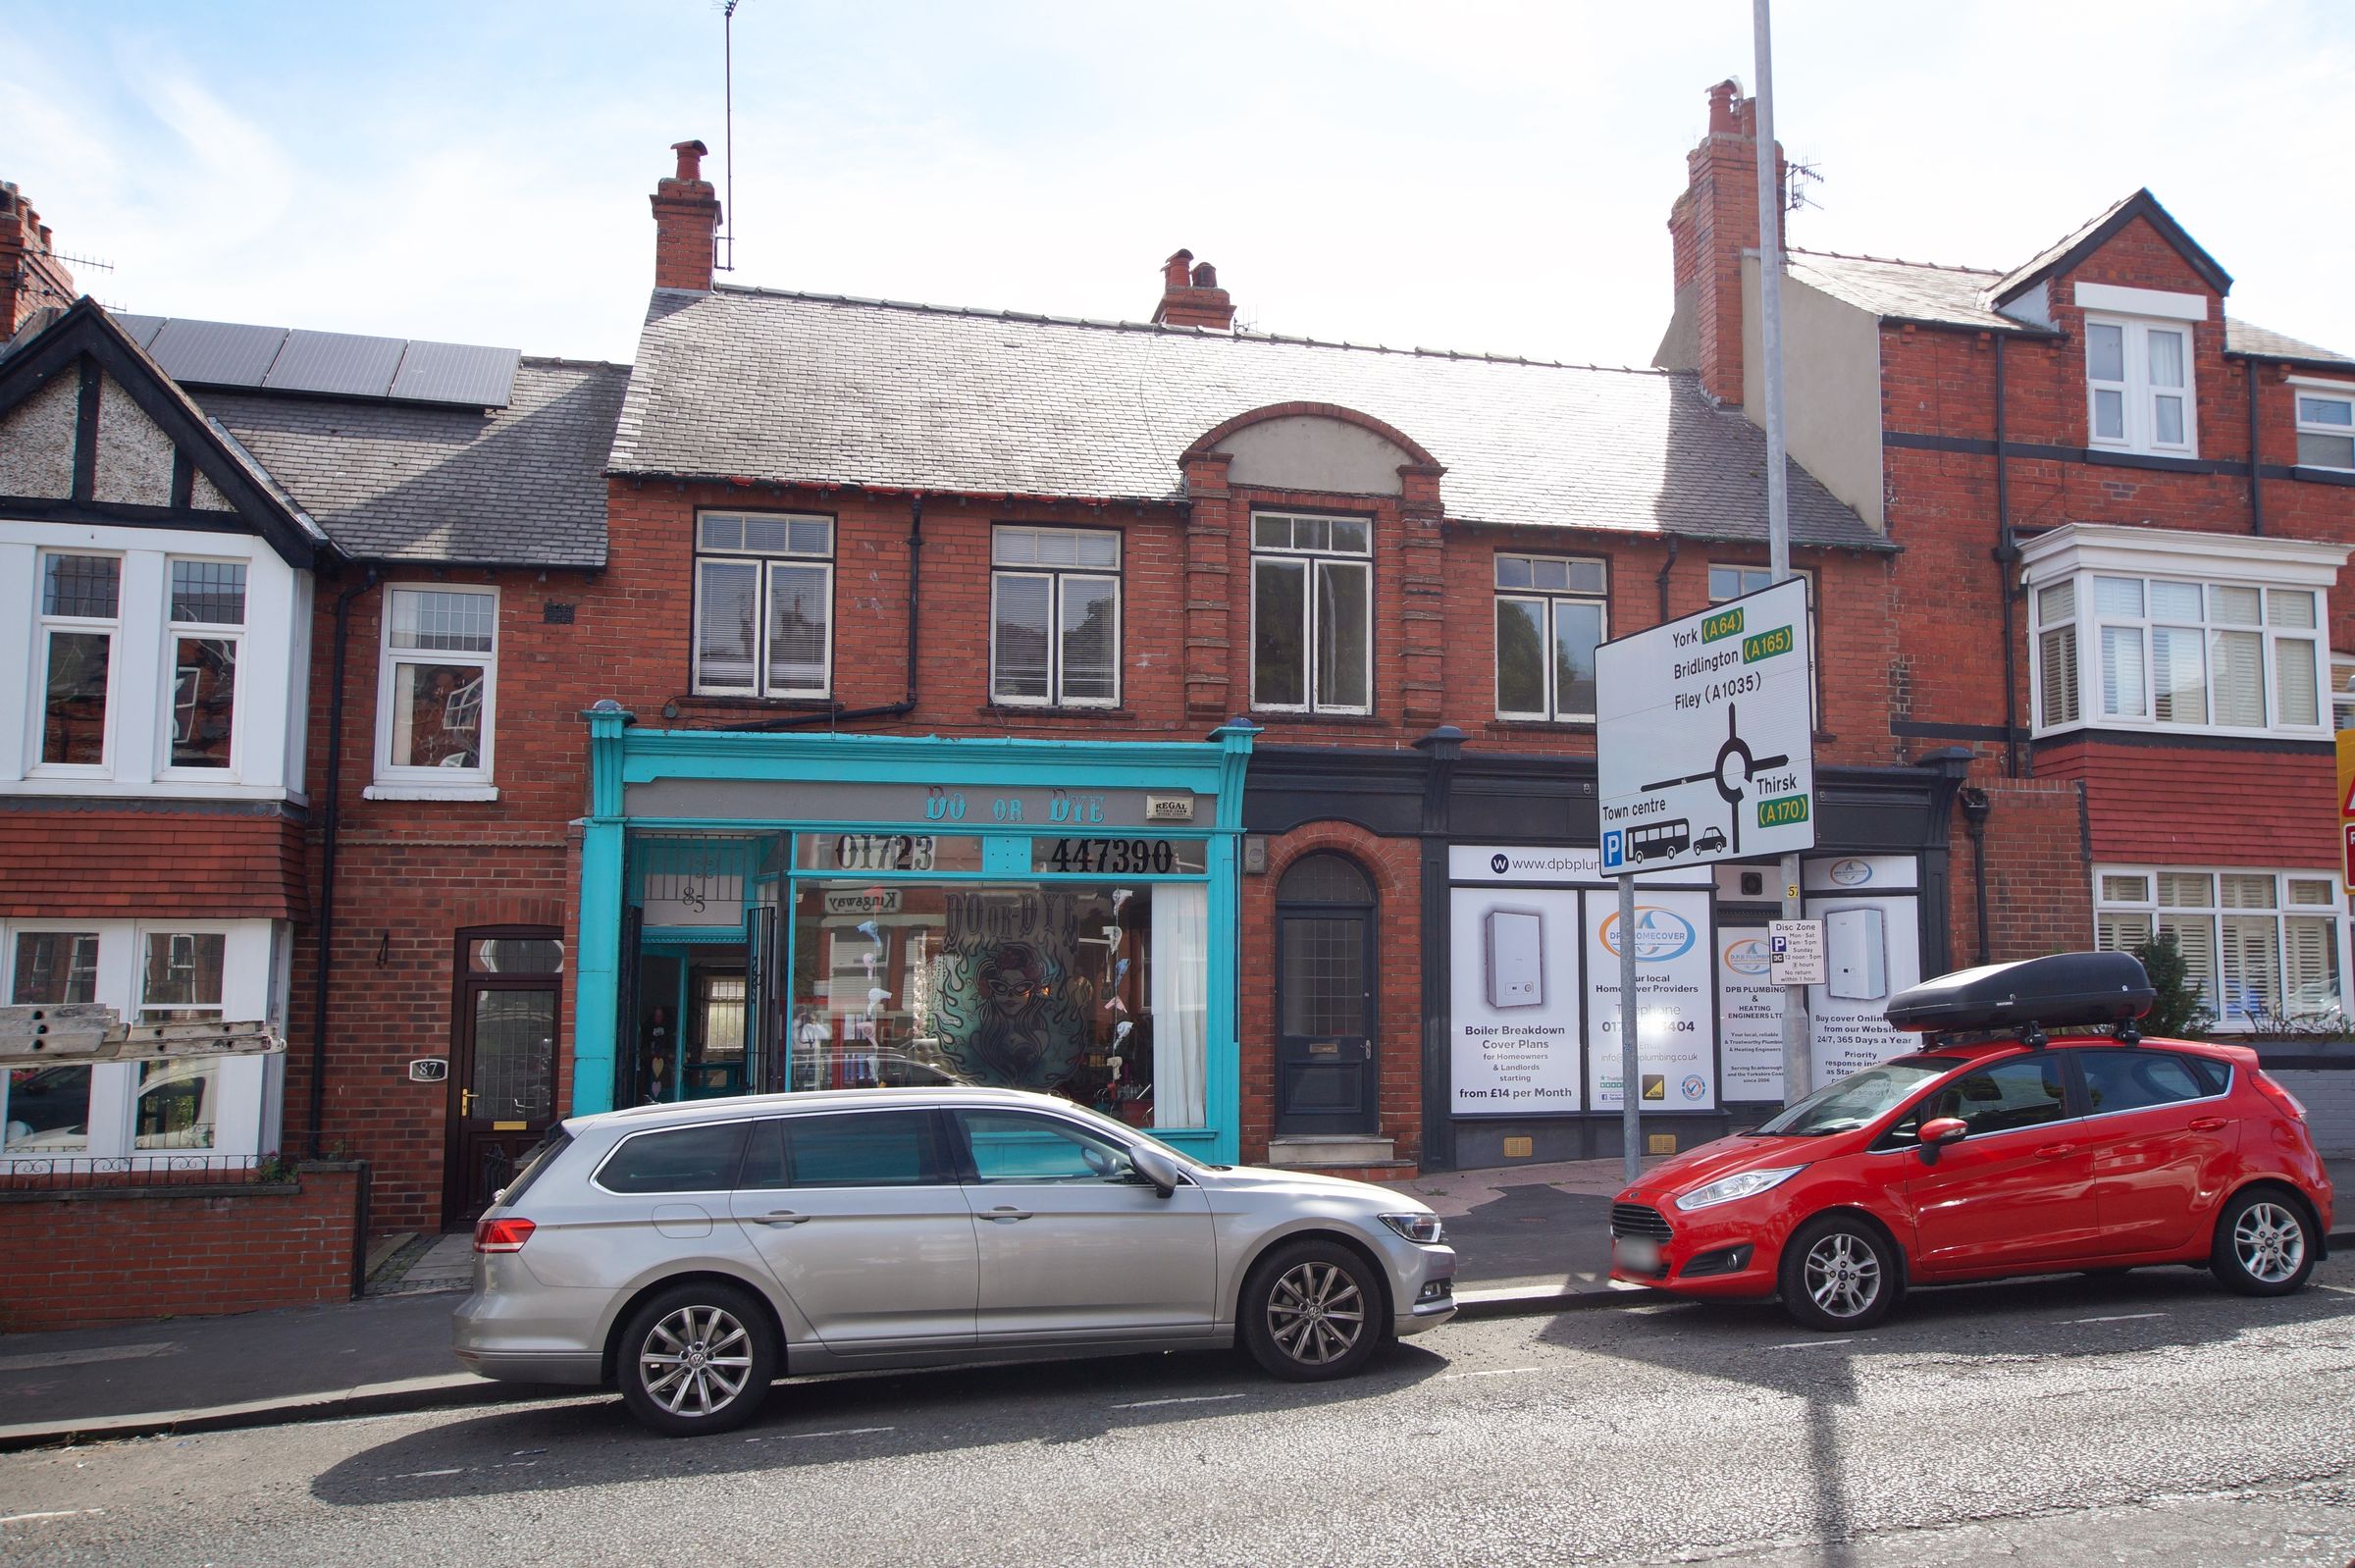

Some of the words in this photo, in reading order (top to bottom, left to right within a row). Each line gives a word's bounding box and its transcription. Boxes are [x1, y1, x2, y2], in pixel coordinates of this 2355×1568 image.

[1672, 628, 1698, 649] York
[1702, 609, 1744, 641] (A64)
[1674, 650, 1739, 679] Bridlington
[1744, 628, 1792, 660] (A165)
[1675, 693, 1701, 710] Filey
[1705, 671, 1761, 704] (A1035)
[1756, 773, 1798, 795] Thirsk
[1155, 801, 1188, 810] REGAL
[1603, 805, 1629, 821] Town
[1632, 798, 1666, 816] centre
[1758, 797, 1807, 825] (A170)
[836, 834, 933, 870] 01723
[1051, 838, 1174, 873] 447390
[1607, 835, 1619, 863] P
[683, 886, 706, 914] 85
[1653, 984, 1699, 993] Providers
[1615, 1004, 1681, 1017] Tphone
[1815, 1015, 1829, 1023] Buy
[1465, 1025, 1499, 1035] Boiler
[1502, 1025, 1565, 1035] Breakdown
[1483, 1040, 1516, 1049] Cover
[1518, 1039, 1549, 1049] Plans
[1856, 1036, 1879, 1045] Days
[1845, 1051, 1878, 1060] Priority
[420, 1063, 439, 1075] 87
[1459, 1088, 1488, 1098] from
[1491, 1088, 1510, 1098] £14
[1512, 1089, 1532, 1099] per
[1534, 1087, 1572, 1097] Month
